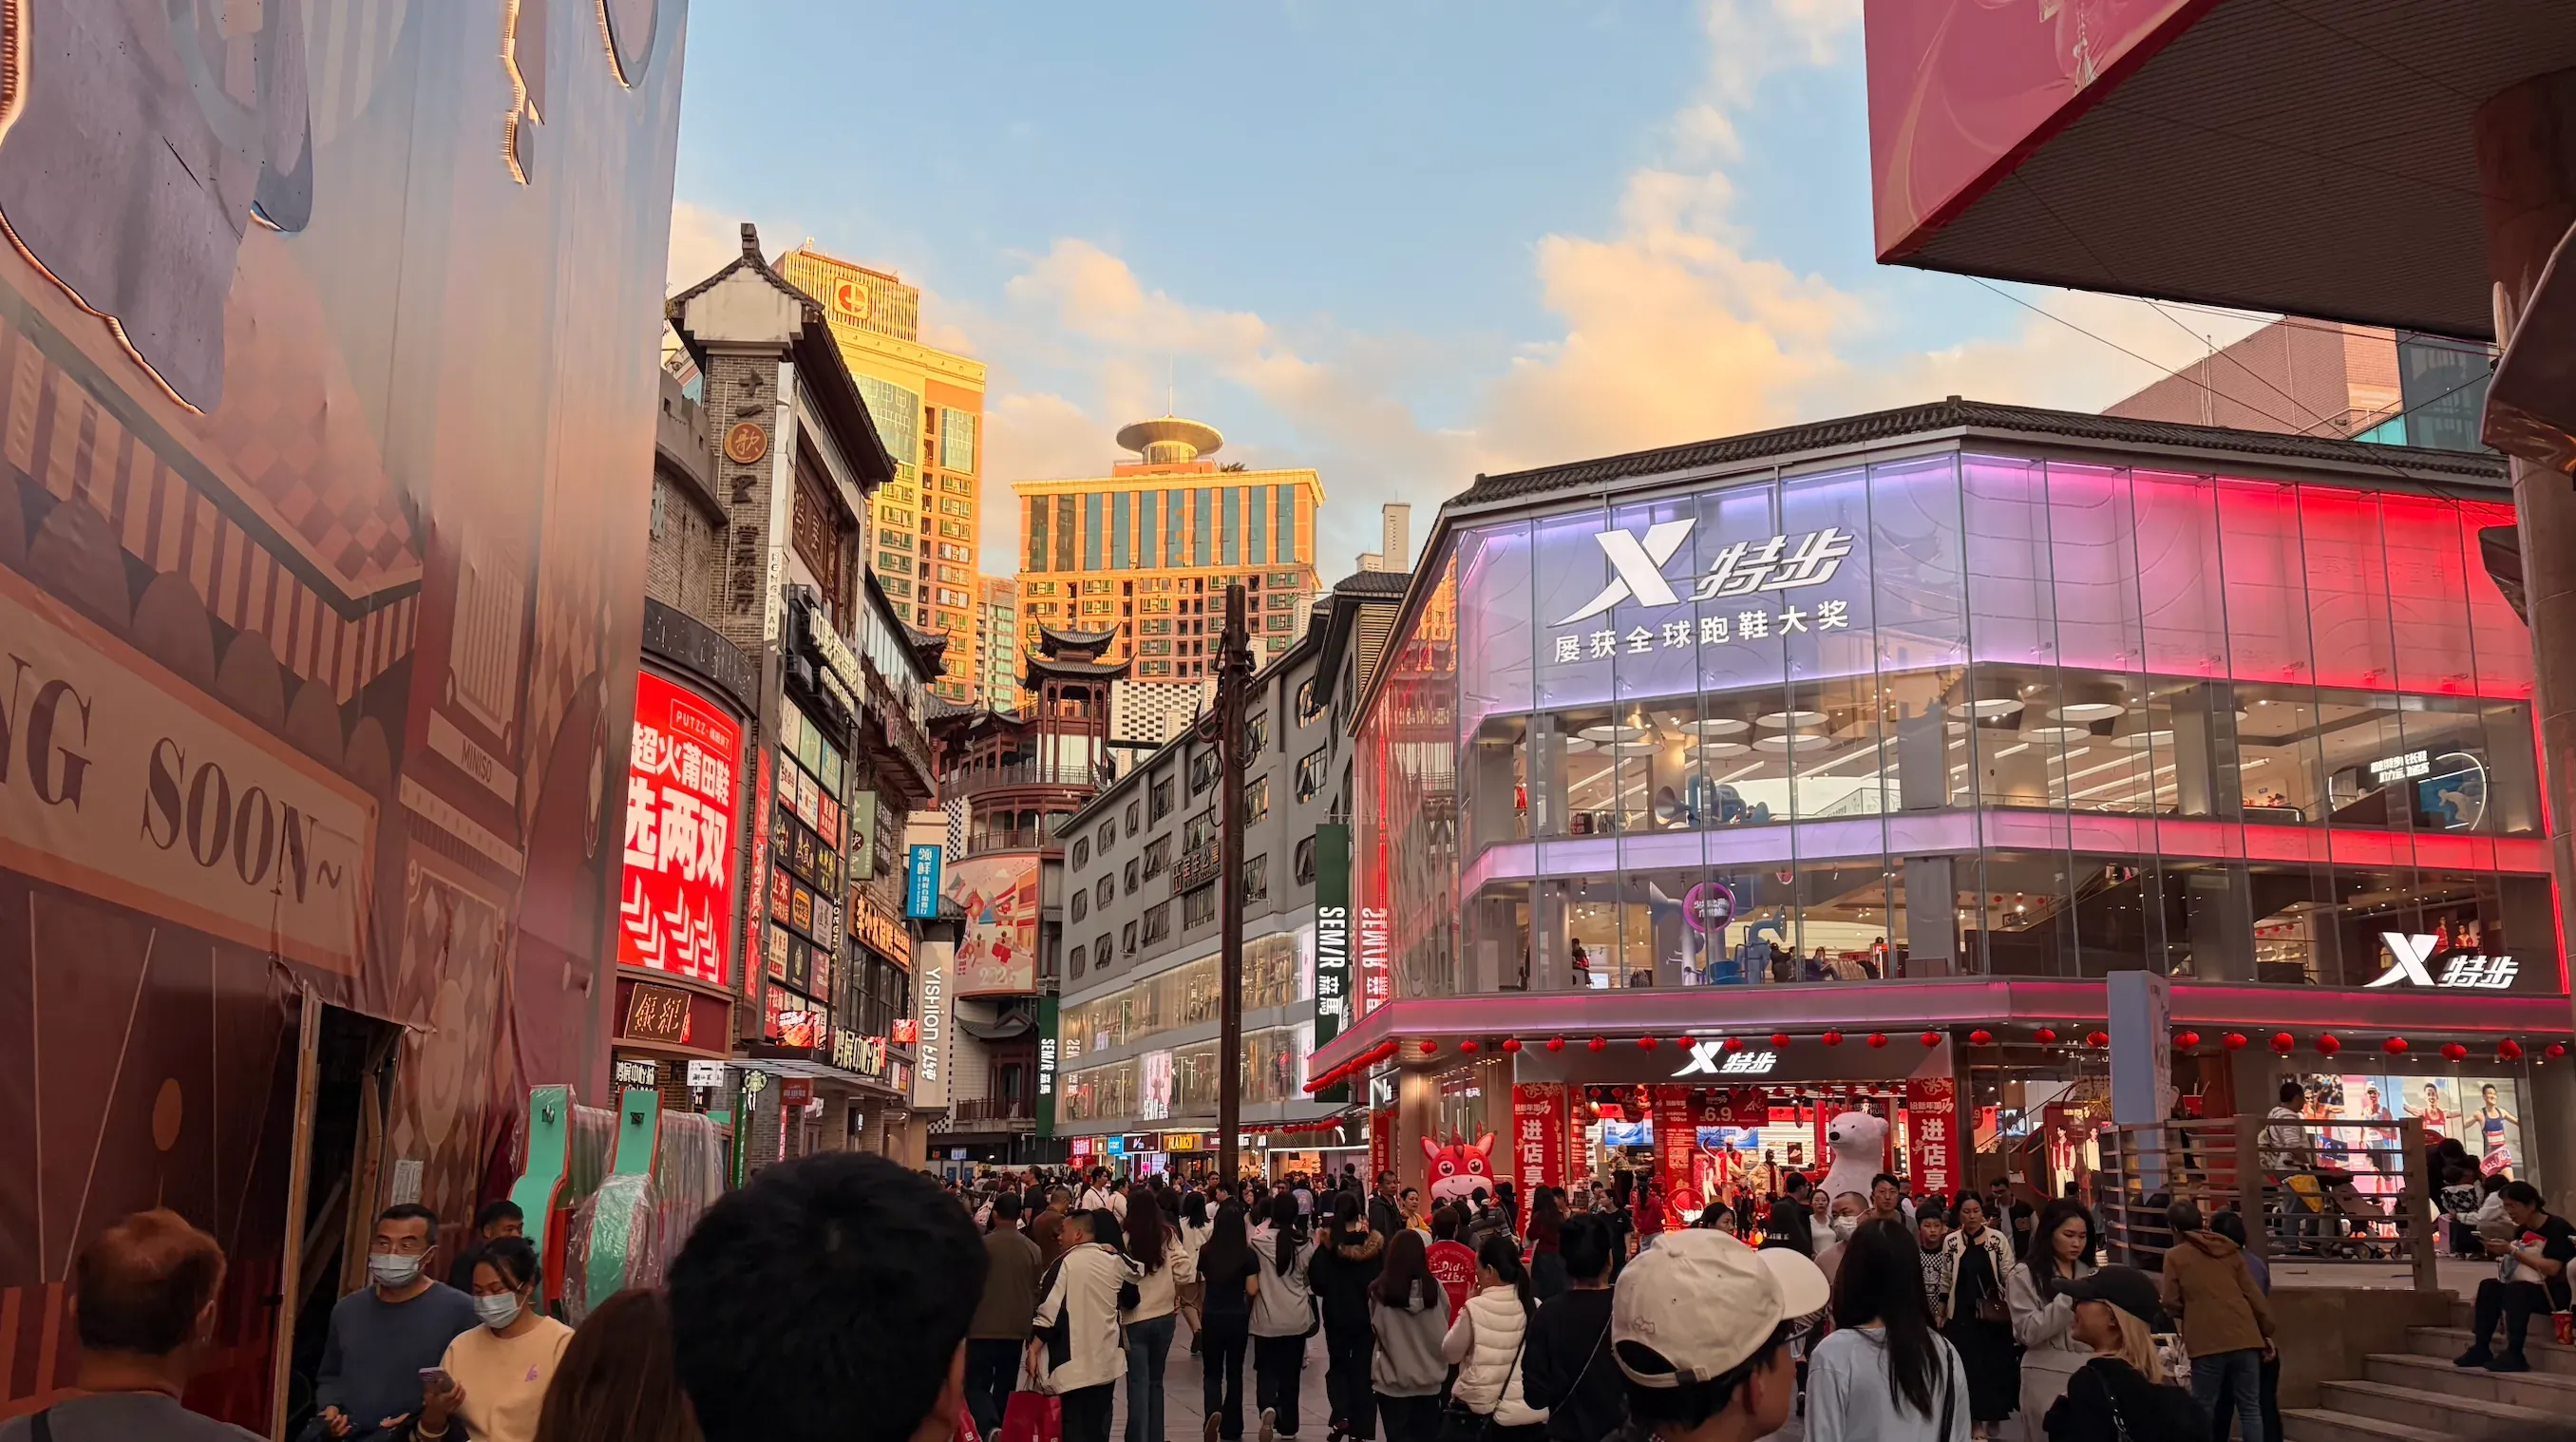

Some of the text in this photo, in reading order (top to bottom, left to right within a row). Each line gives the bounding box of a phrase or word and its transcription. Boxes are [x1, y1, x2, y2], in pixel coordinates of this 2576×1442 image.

[1687, 526, 1855, 603] 特步
[1554, 599, 1849, 663] 屡获全球跑鞋大奖
[462, 738, 492, 784] MINISO
[632, 720, 730, 807] 超火莆田鞋
[2437, 954, 2519, 989] 特步
[1722, 1050, 1777, 1075] 特步
